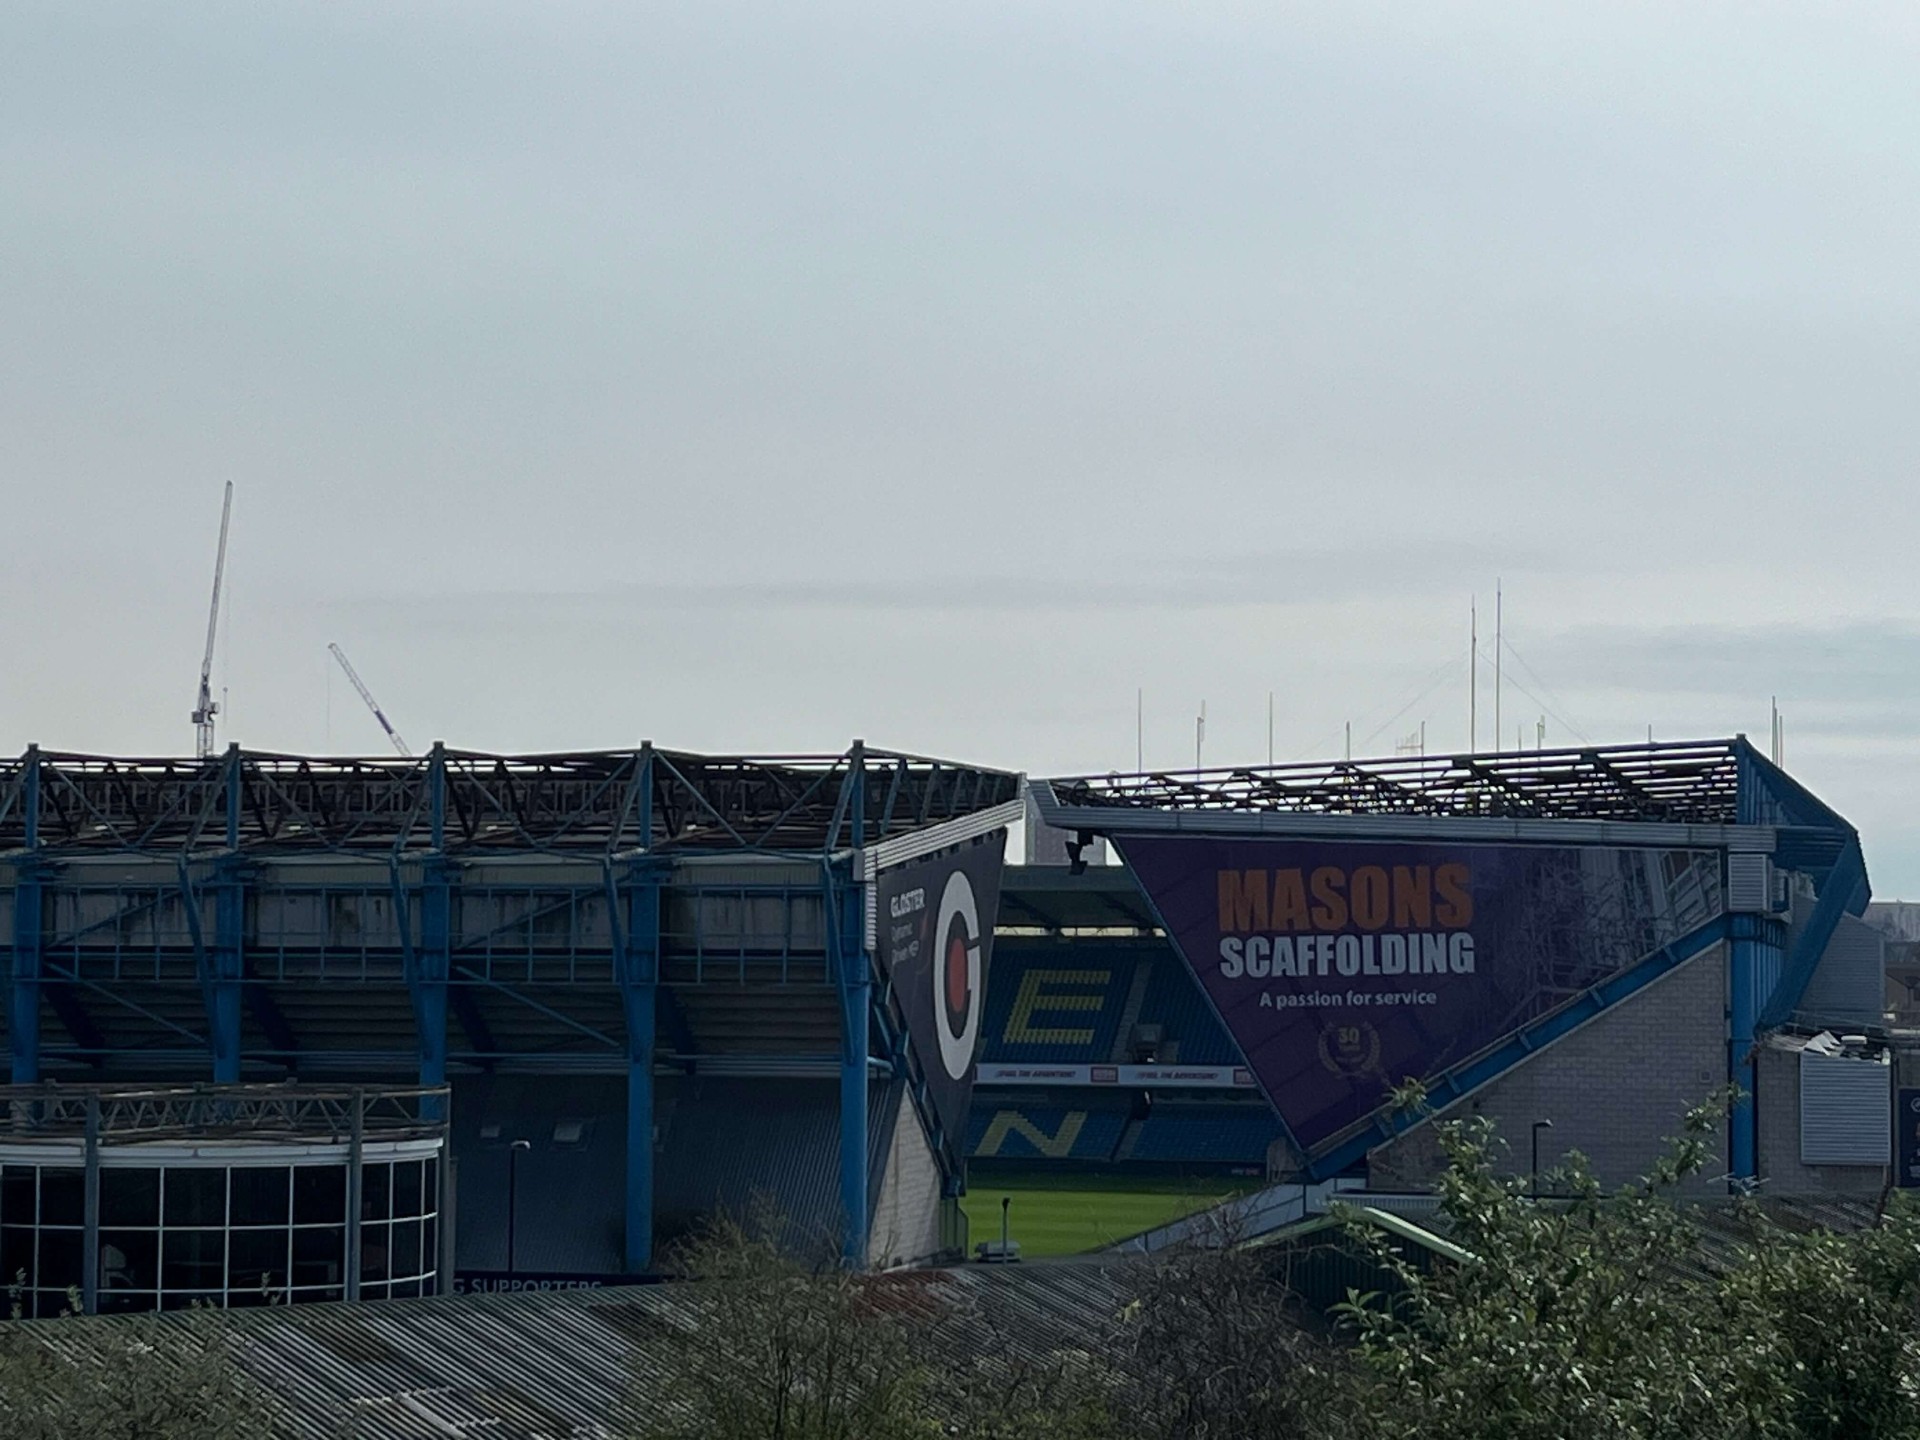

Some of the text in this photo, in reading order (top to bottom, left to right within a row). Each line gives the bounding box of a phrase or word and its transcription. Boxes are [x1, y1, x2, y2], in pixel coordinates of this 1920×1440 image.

[1218, 864, 1473, 931] MASONS
[1219, 932, 1475, 978] SCAFFOLDING
[1002, 969, 1111, 1044] E
[1259, 989, 1437, 1010] A passion for service
[1338, 1027, 1360, 1044] 30
[974, 1110, 1088, 1157] N
